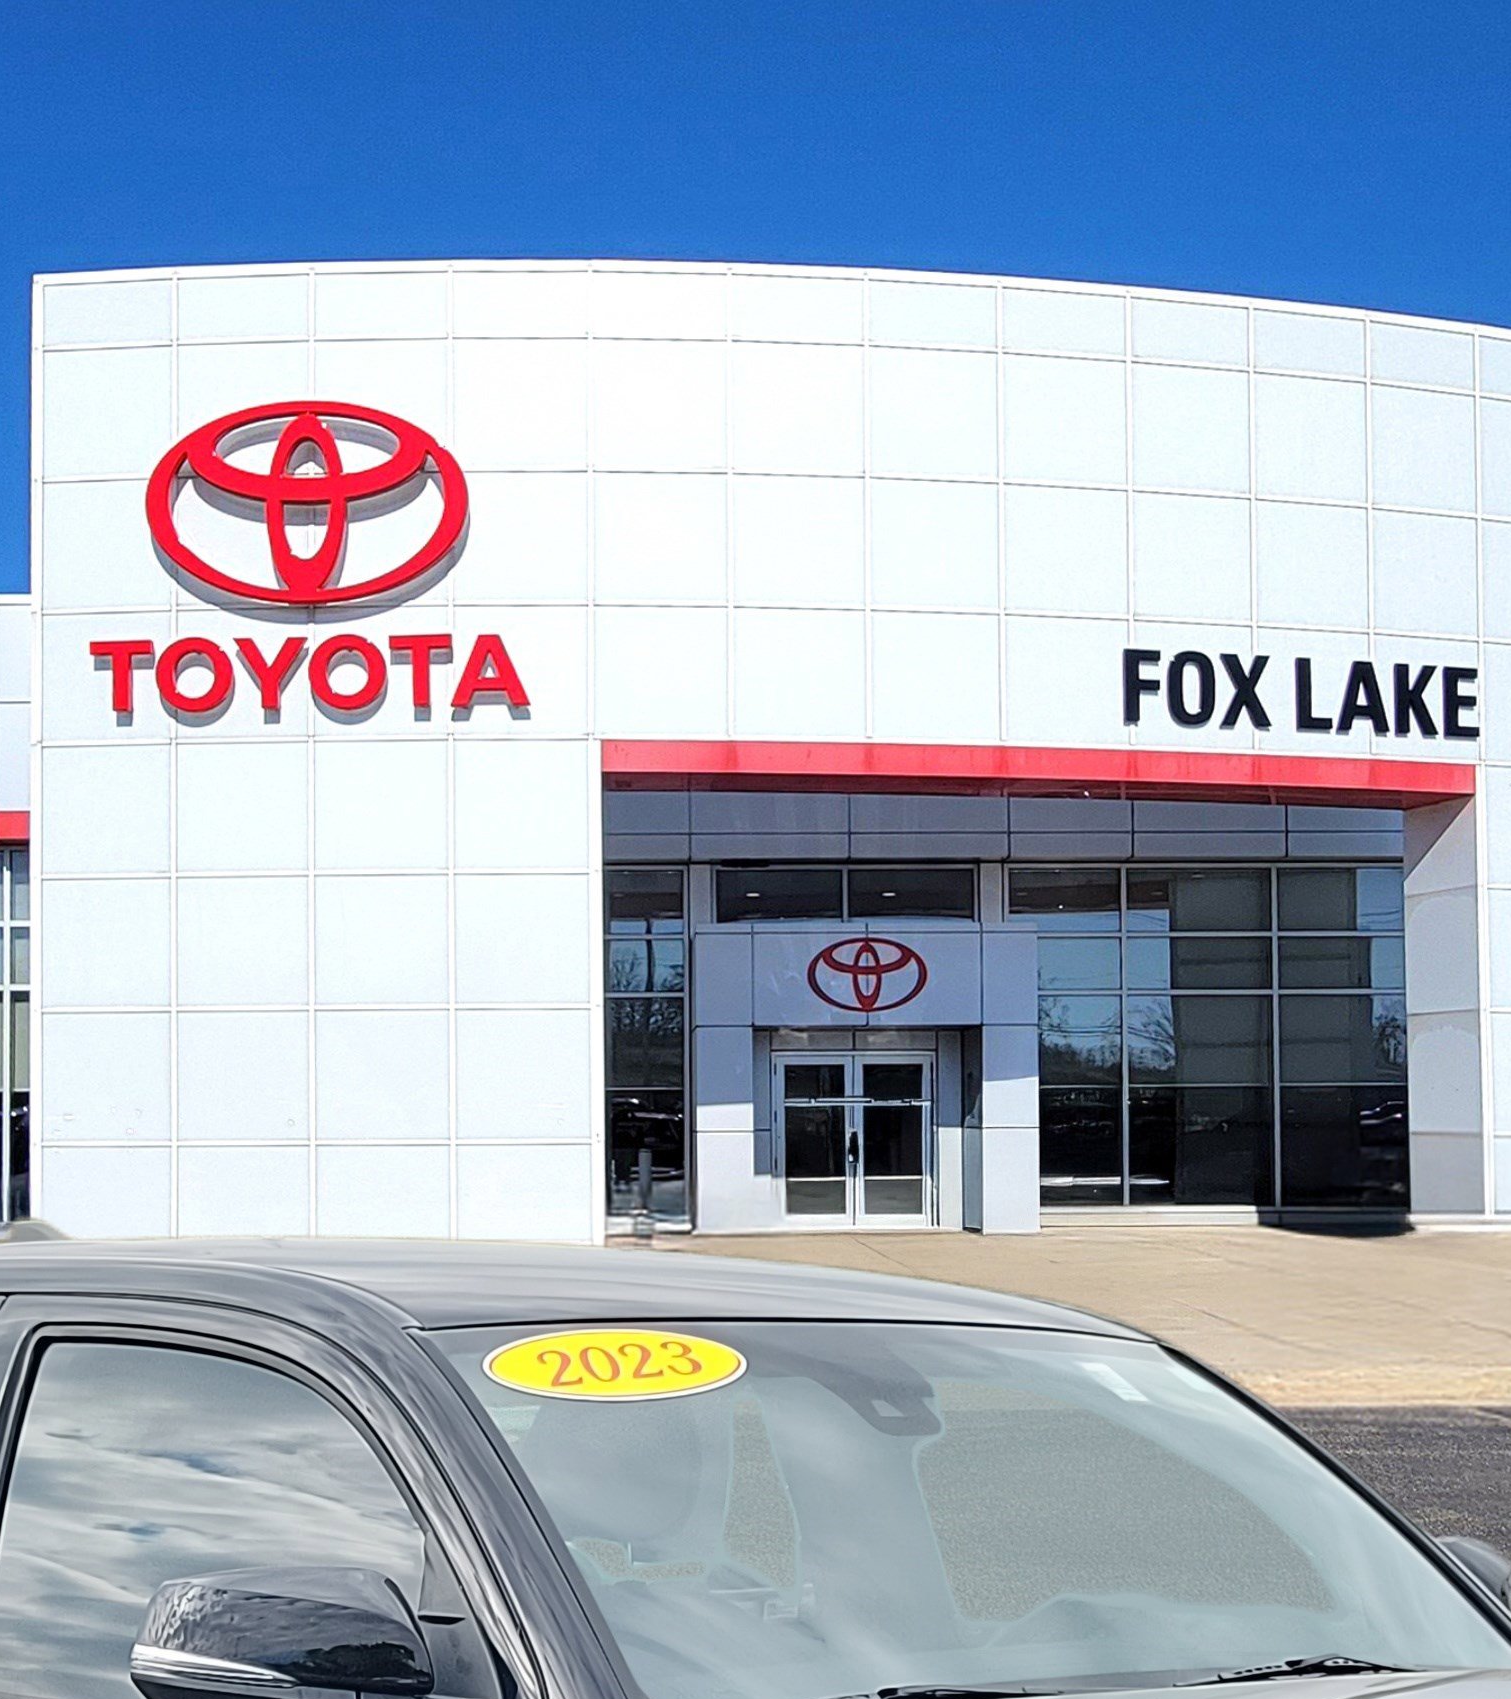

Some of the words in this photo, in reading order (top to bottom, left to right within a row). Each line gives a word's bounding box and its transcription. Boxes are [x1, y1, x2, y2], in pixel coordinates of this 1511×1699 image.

[90, 634, 530, 716] TOYOTA
[1124, 650, 1270, 727] FOX
[1296, 659, 1479, 737] LAKE
[536, 1342, 702, 1388] 2023
